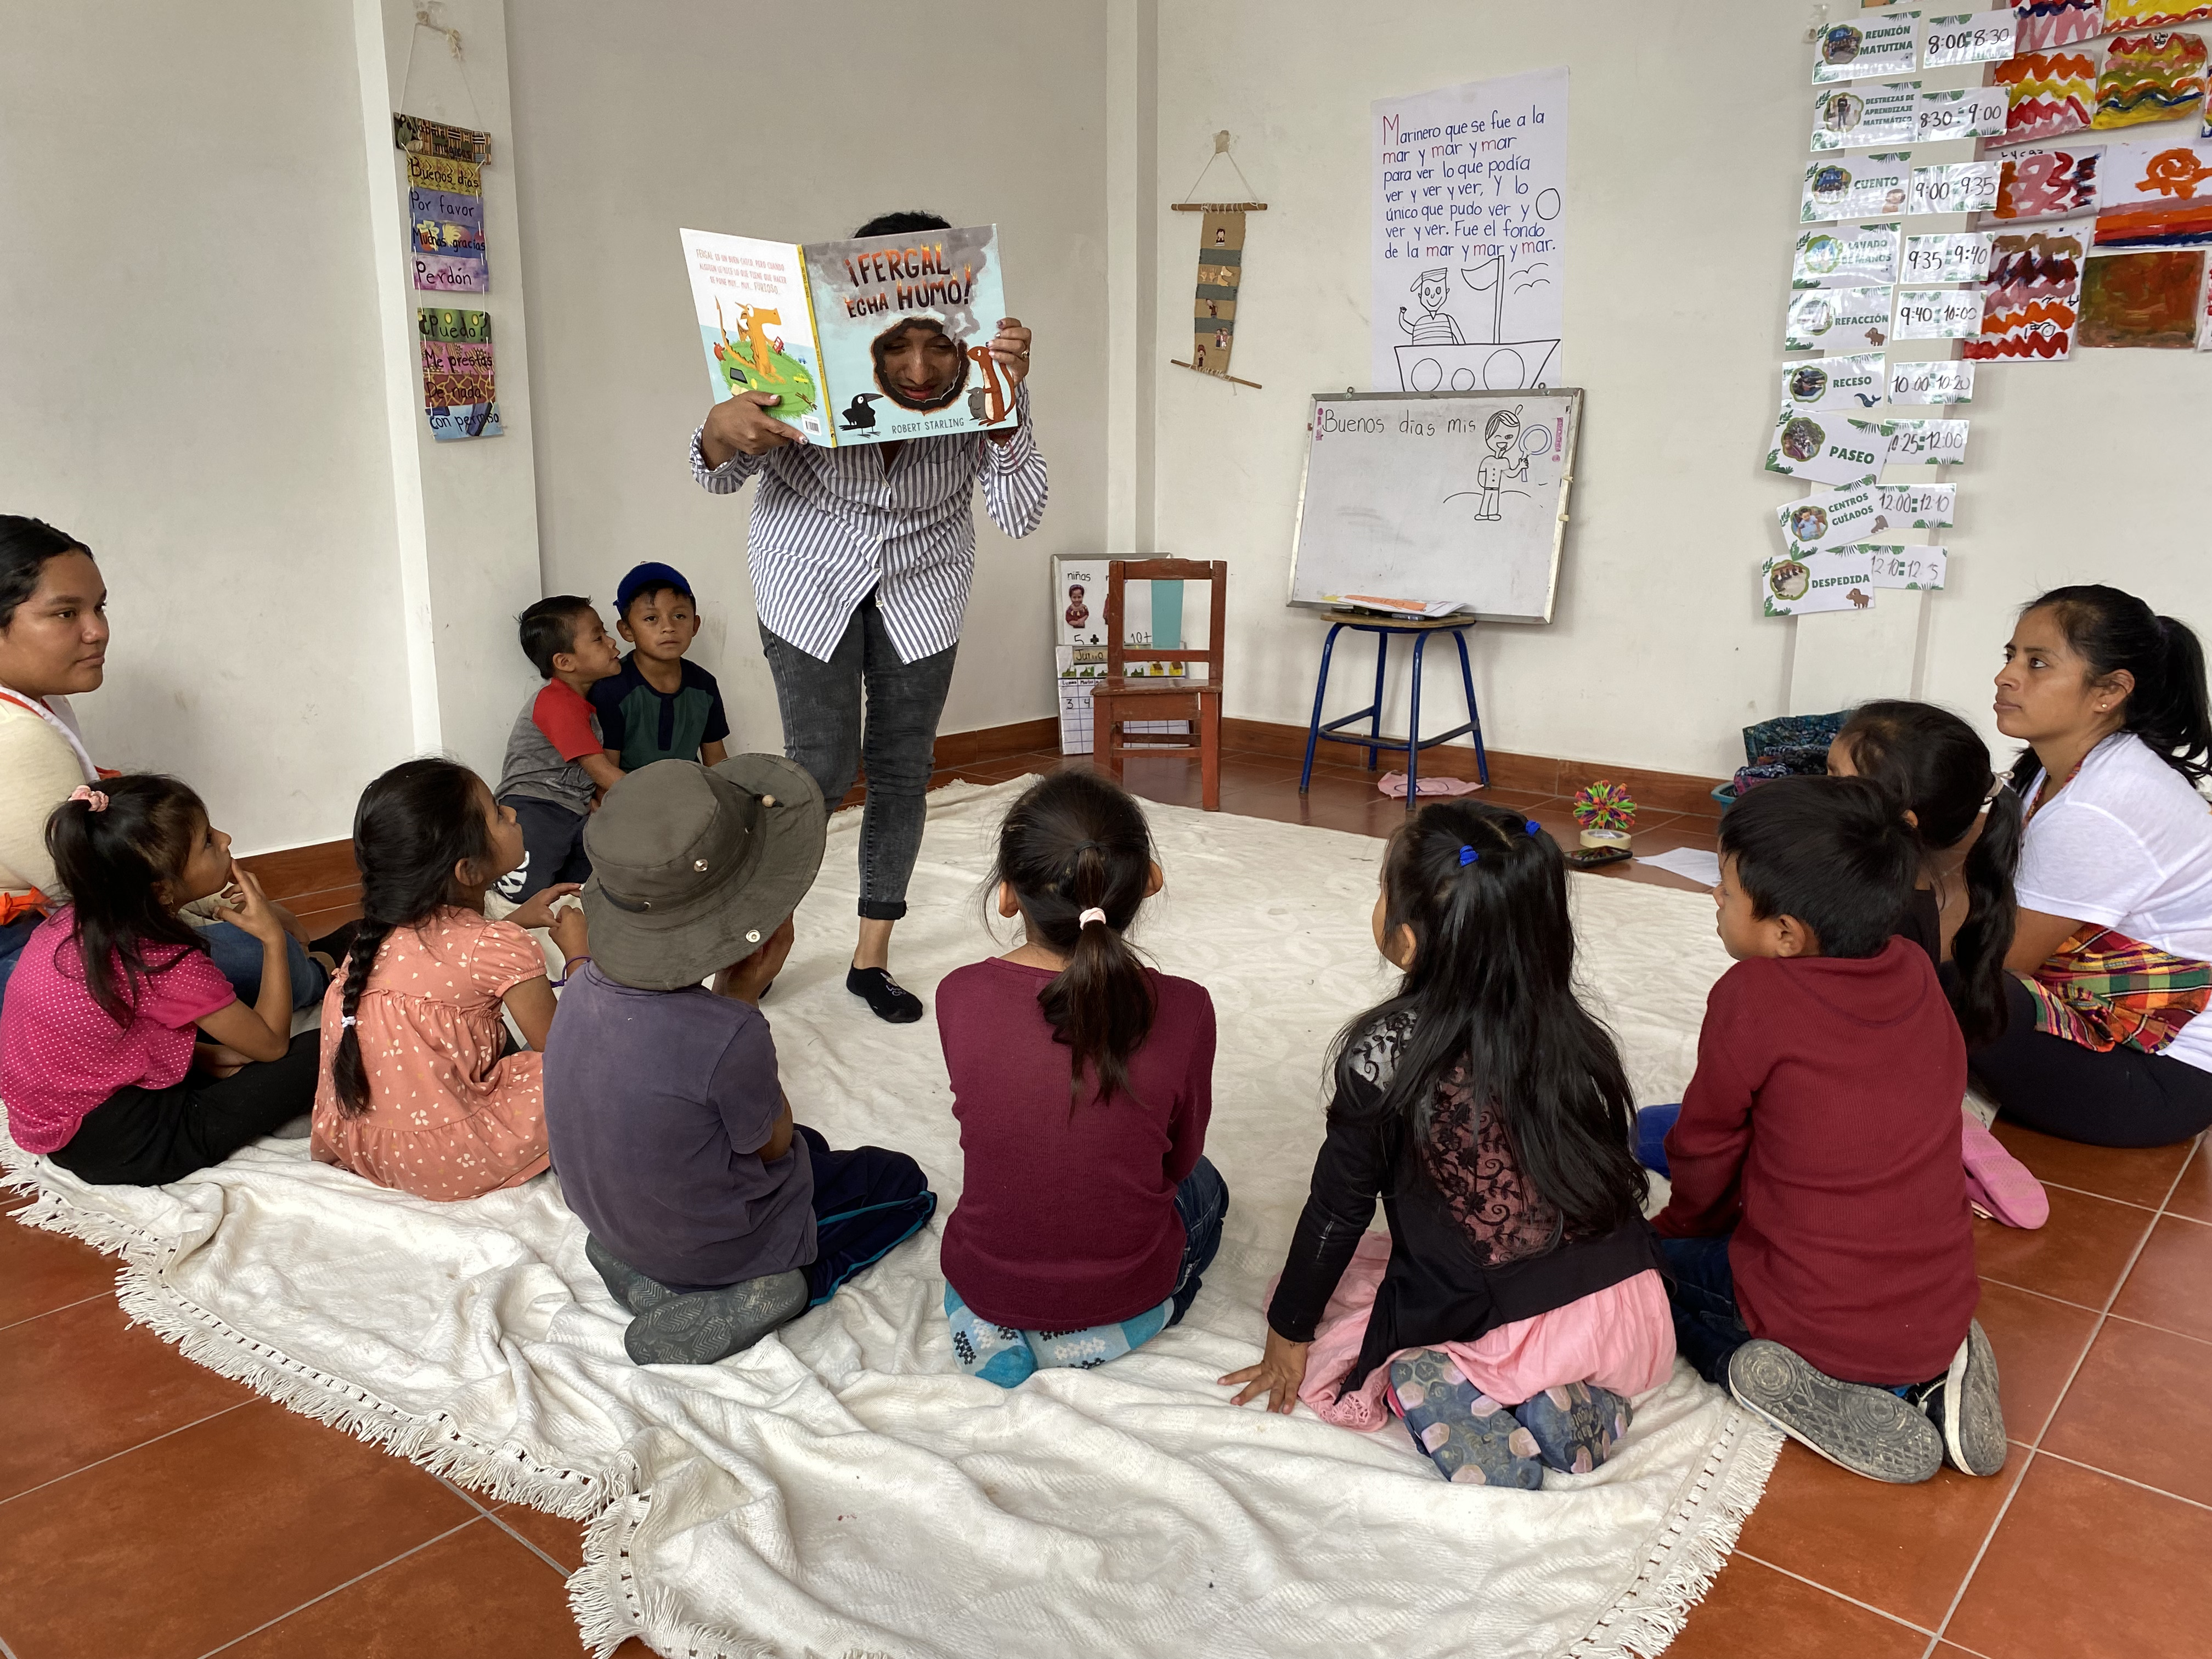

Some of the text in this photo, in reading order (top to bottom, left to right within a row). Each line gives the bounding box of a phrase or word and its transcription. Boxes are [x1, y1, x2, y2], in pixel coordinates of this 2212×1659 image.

[1865, 25, 1911, 40] REUNIÓN
[1928, 29, 2009, 54] 8:00 8:30
[1860, 41, 1913, 55] MATUTINA
[1865, 105, 1913, 115] APRENDIZAJE
[1866, 95, 1904, 105] DESTREZAS
[1383, 104, 1545, 146] Marinero que se fue a la
[1863, 116, 1912, 126] MATEMÁTICO
[1920, 104, 2001, 128] 8:30 9:00
[1383, 137, 1517, 167] mar y mar y mar
[410, 156, 479, 188] Buenos días
[1384, 154, 1530, 190] para ver lo que podía
[1854, 176, 1899, 189] CUENTO
[1385, 191, 1403, 202] ver
[1411, 190, 1417, 203] y
[1423, 185, 1442, 198] ver
[1447, 187, 1454, 200] y
[1458, 183, 1483, 196] ver,
[1515, 175, 1528, 195] lo
[1916, 176, 1995, 200] 9:00 9:35
[410, 190, 475, 217] Por favor
[1386, 201, 1530, 222] único que pudo ver y
[412, 228, 486, 252] Muchas gracias
[1385, 218, 1545, 241] ver y ver. Fue el fondo
[1385, 239, 1556, 262] de la mar y mar y mar.
[1849, 240, 1888, 249] LAVADO
[844, 243, 951, 288] ¡FERGAL
[1909, 245, 1988, 270] 9:35 9:40
[415, 260, 472, 285] Perdón
[843, 263, 972, 319] ECHA HUMO!
[1835, 313, 1888, 326] REFACCIÓN
[1901, 304, 1977, 325] 9:40 10:00
[419, 312, 490, 342] ¿Puedo?
[425, 349, 493, 374] Me prestas
[426, 381, 481, 399] De nada
[1833, 376, 1872, 388] RECESO
[1891, 375, 1971, 393] 10:00 10:20
[454, 412, 499, 432] permiso
[891, 417, 964, 435] ROBERT STARLING
[1400, 410, 1435, 436] días
[1448, 418, 1476, 433] mis
[1926, 431, 1962, 450] 12:00
[1829, 445, 1875, 465] PASEO
[1828, 492, 1869, 513] CENTROS
[1880, 493, 1949, 513] 12:00 12:10
[1832, 505, 1874, 526] GUÍADOS
[1068, 572, 1091, 582] niñas
[1812, 574, 1870, 589] DESPEDIDA
[1066, 698, 1090, 709] 3 4
